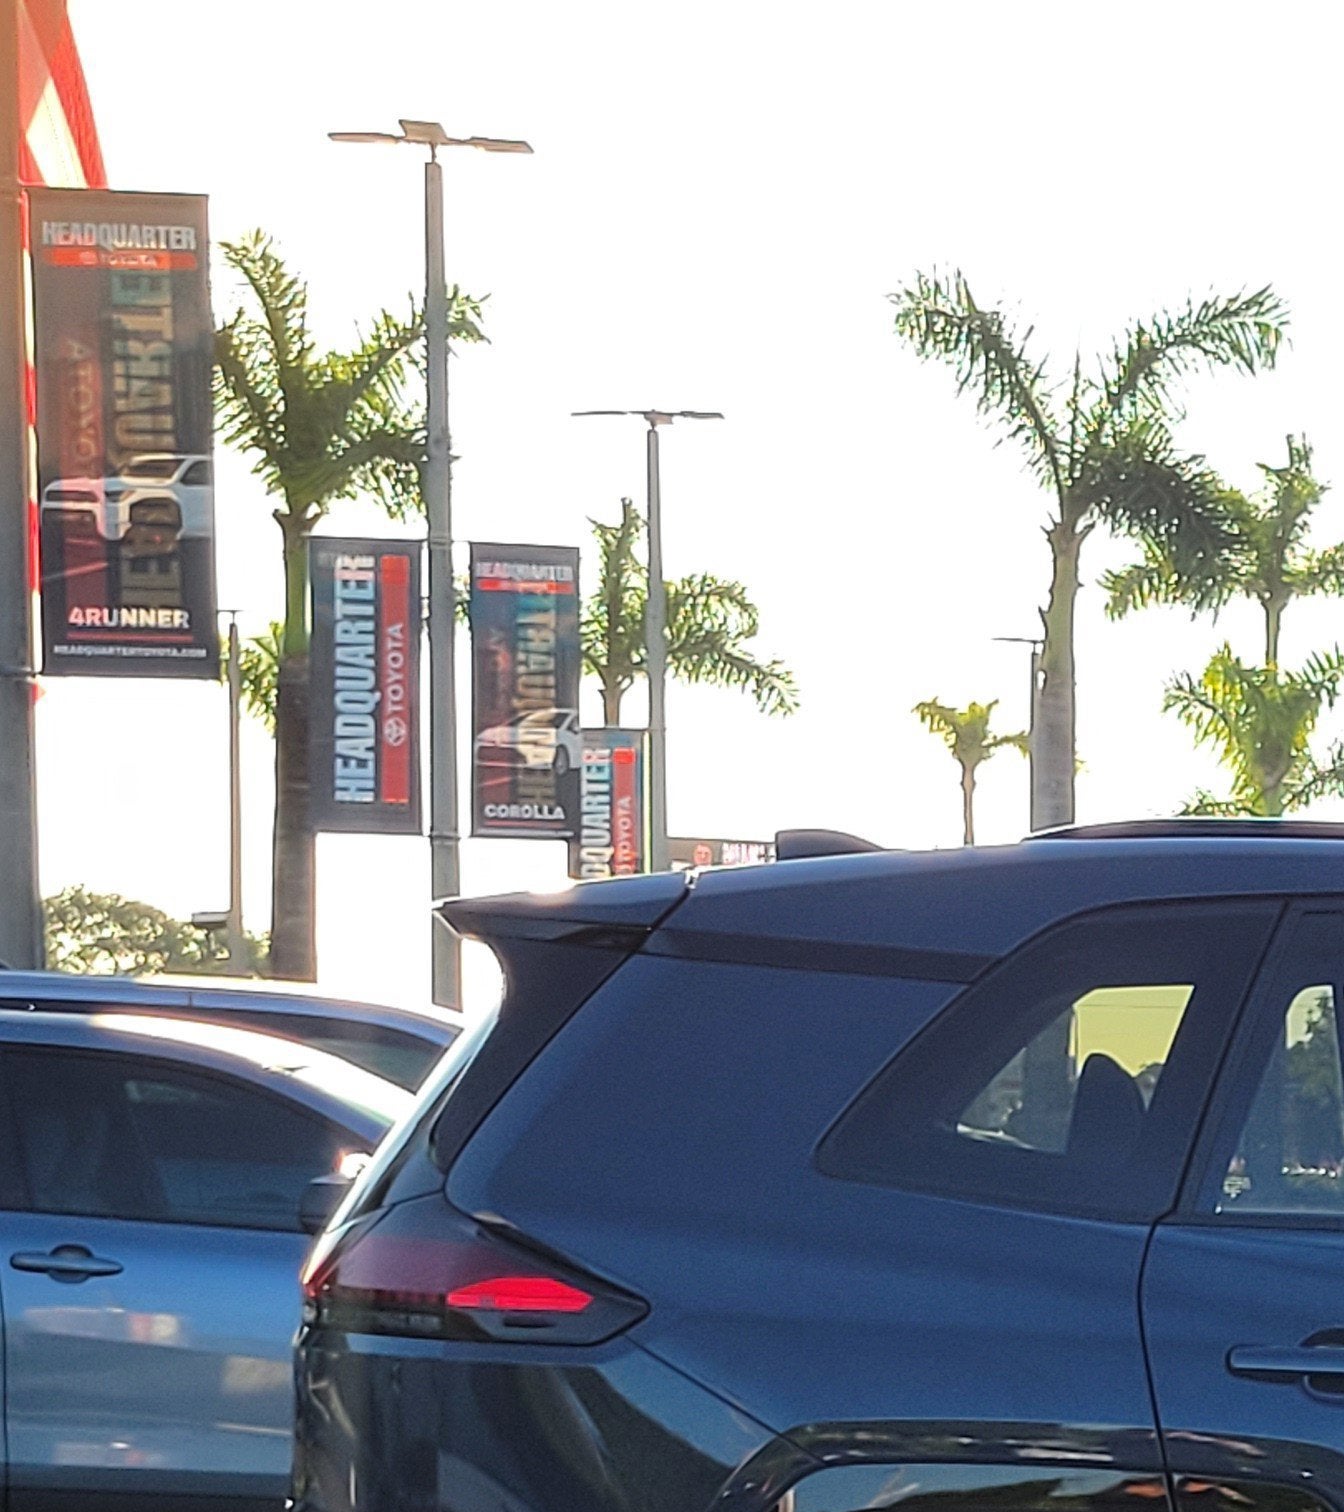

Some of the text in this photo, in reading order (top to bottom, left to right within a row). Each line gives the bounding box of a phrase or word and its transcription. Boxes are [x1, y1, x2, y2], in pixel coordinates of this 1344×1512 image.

[41, 221, 197, 252] HEADQUARTER
[67, 605, 191, 629] 4RUNNER
[333, 554, 382, 804] HEADQUARTER
[387, 622, 405, 714] TOYOTA
[483, 803, 566, 820] COROLLA
[580, 748, 614, 878] DQUARTER
